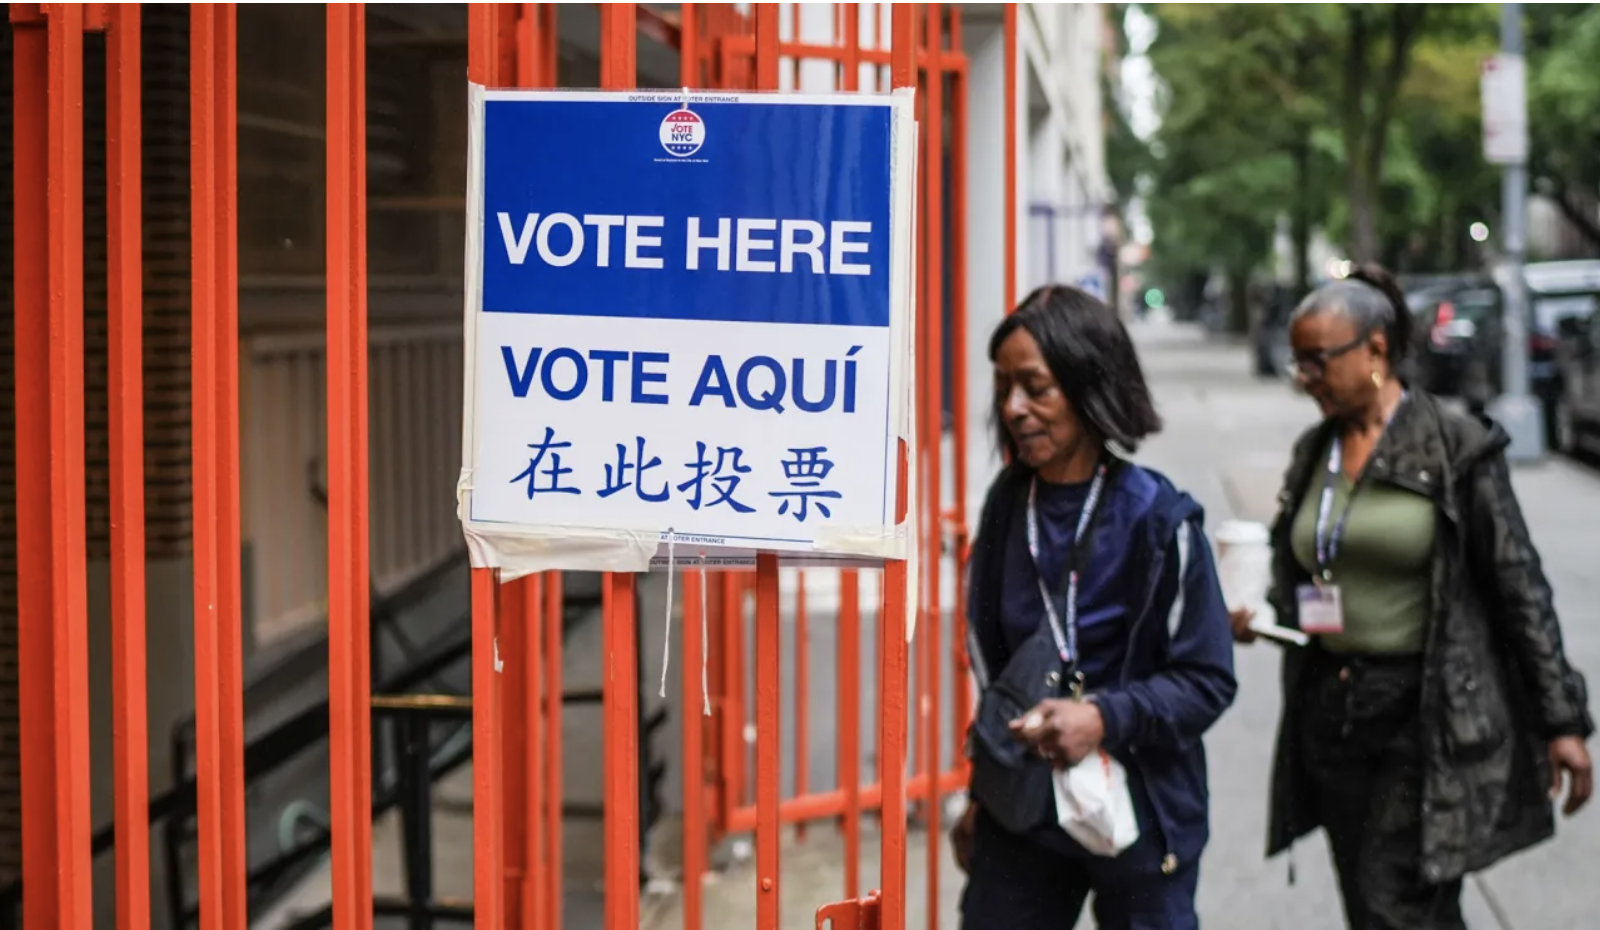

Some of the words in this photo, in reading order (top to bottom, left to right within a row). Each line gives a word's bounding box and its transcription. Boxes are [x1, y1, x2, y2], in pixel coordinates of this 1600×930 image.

[671, 133, 693, 142] NYC
[497, 212, 665, 269] VOTE
[685, 216, 872, 276] HERE
[501, 345, 670, 405] VOTE
[688, 345, 863, 414] AQUÍ
[509, 426, 843, 523] 在此投票
